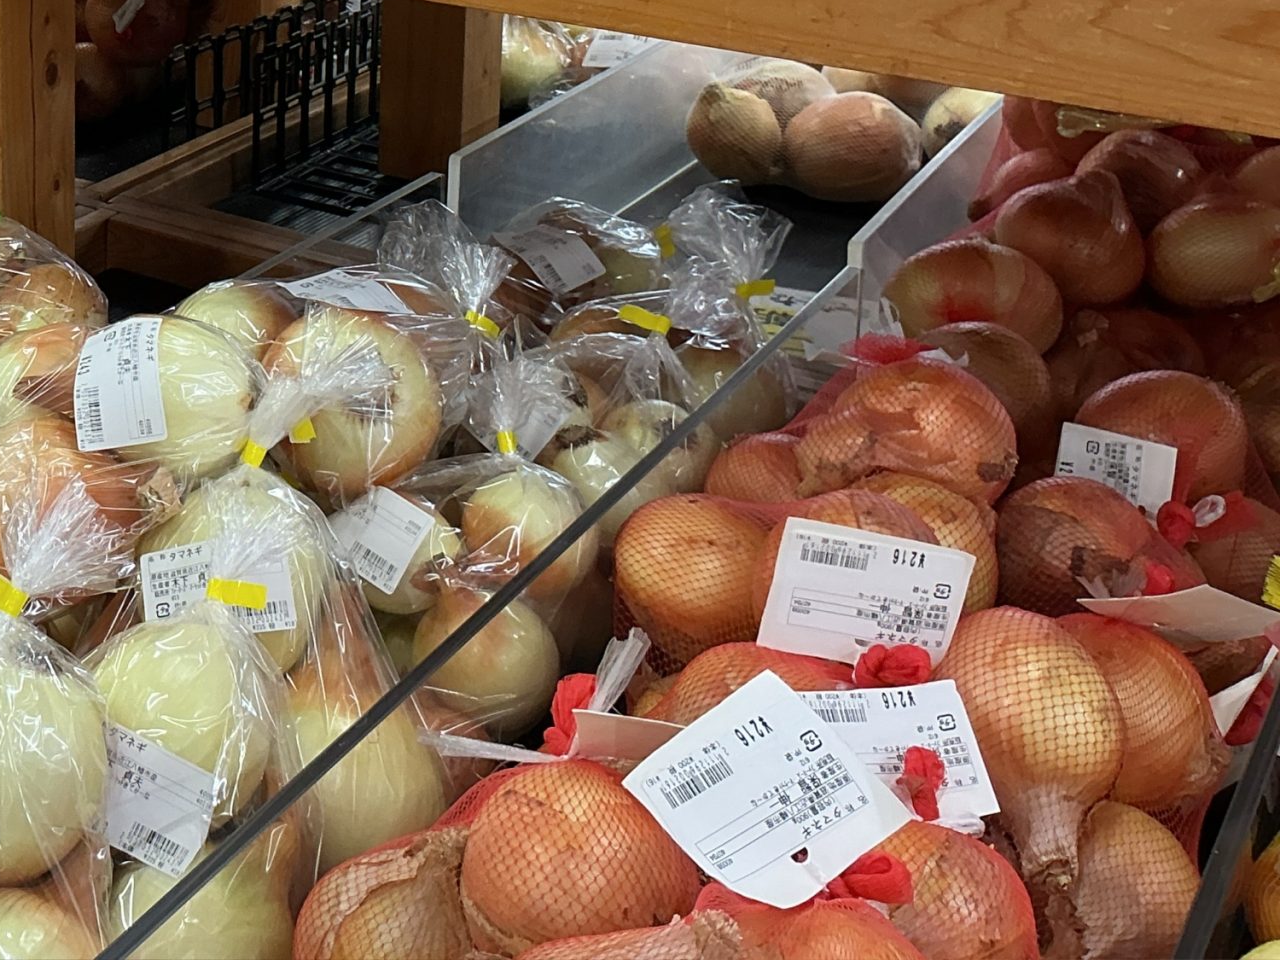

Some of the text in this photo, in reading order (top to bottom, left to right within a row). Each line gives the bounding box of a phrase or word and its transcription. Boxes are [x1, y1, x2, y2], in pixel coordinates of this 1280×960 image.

[169, 546, 202, 560] タマネギ
[891, 547, 926, 568] ¥216
[880, 689, 916, 709] ¥216
[108, 726, 147, 755] タマネギ
[732, 712, 773, 748] ¥216
[122, 768, 143, 788] 貞夫
[763, 785, 830, 828] 滋賀県近江八幡市産
[797, 806, 846, 838] タマネギ
